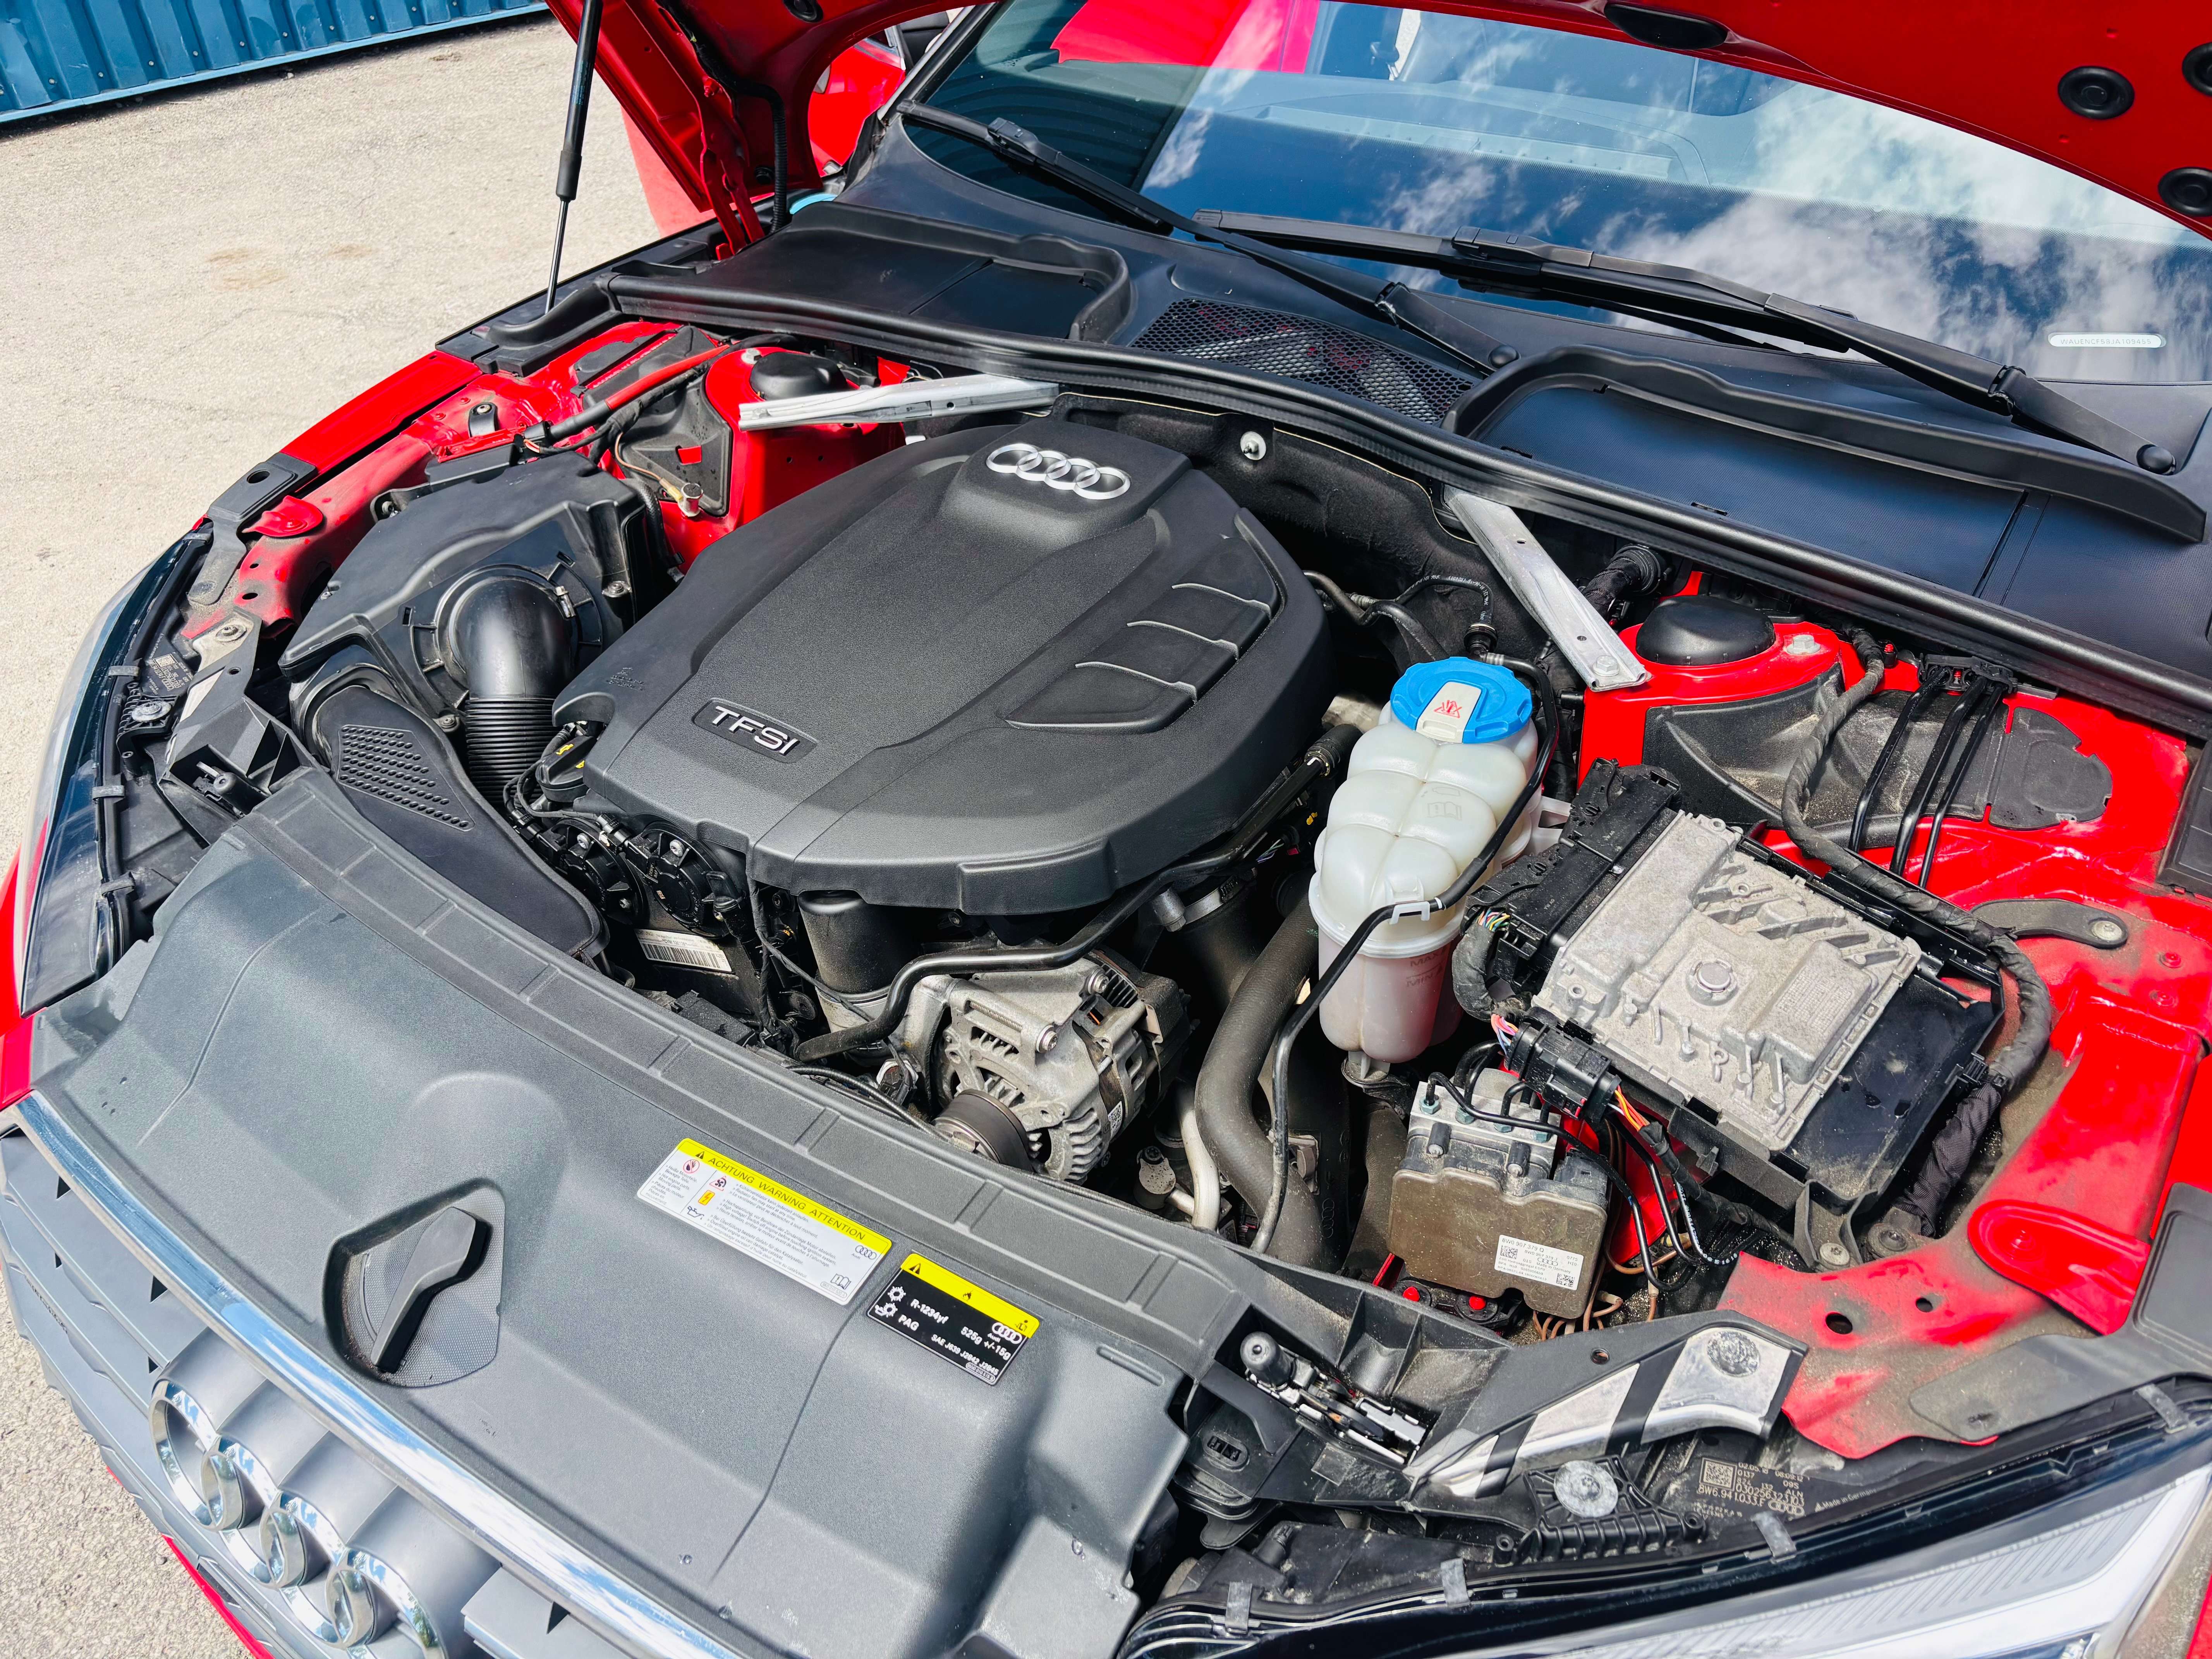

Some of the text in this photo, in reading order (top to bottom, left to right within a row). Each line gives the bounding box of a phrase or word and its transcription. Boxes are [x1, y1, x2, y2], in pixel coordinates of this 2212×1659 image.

[713, 706, 799, 755] TFSI
[658, 1177, 672, 1186] Moving
[665, 1169, 680, 1179] Bewegte
[667, 1177, 680, 1185] engine
[670, 1190, 684, 1199] moteur
[708, 1157, 866, 1240] ACHTUNG WARNING ATTENTION
[735, 1188, 751, 1198] Radiator
[727, 1229, 741, 1238] engine
[752, 1242, 768, 1252] damage
[731, 1208, 747, 1218] voltage!
[746, 1216, 760, 1224] Switch
[764, 1226, 778, 1235] engine
[778, 1232, 791, 1241] before
[790, 1239, 807, 1250] touching
[806, 1248, 822, 1258] ignition
[741, 1230, 756, 1239] besteht
[754, 1237, 768, 1246] Gefahr
[761, 1230, 775, 1238] moteur
[791, 1245, 806, 1255] toucher
[1553, 1266, 1571, 1274] Germany
[908, 1298, 949, 1326] R-1234yf
[897, 1314, 920, 1331] PAG
[958, 1326, 984, 1345] 525g
[986, 1332, 1001, 1343] Audi
[930, 1334, 946, 1346] SAE
[943, 1341, 962, 1355] J639
[959, 1350, 981, 1365] J2842
[1822, 1499, 1840, 1508] Made
[1847, 1488, 1877, 1501] Germany
